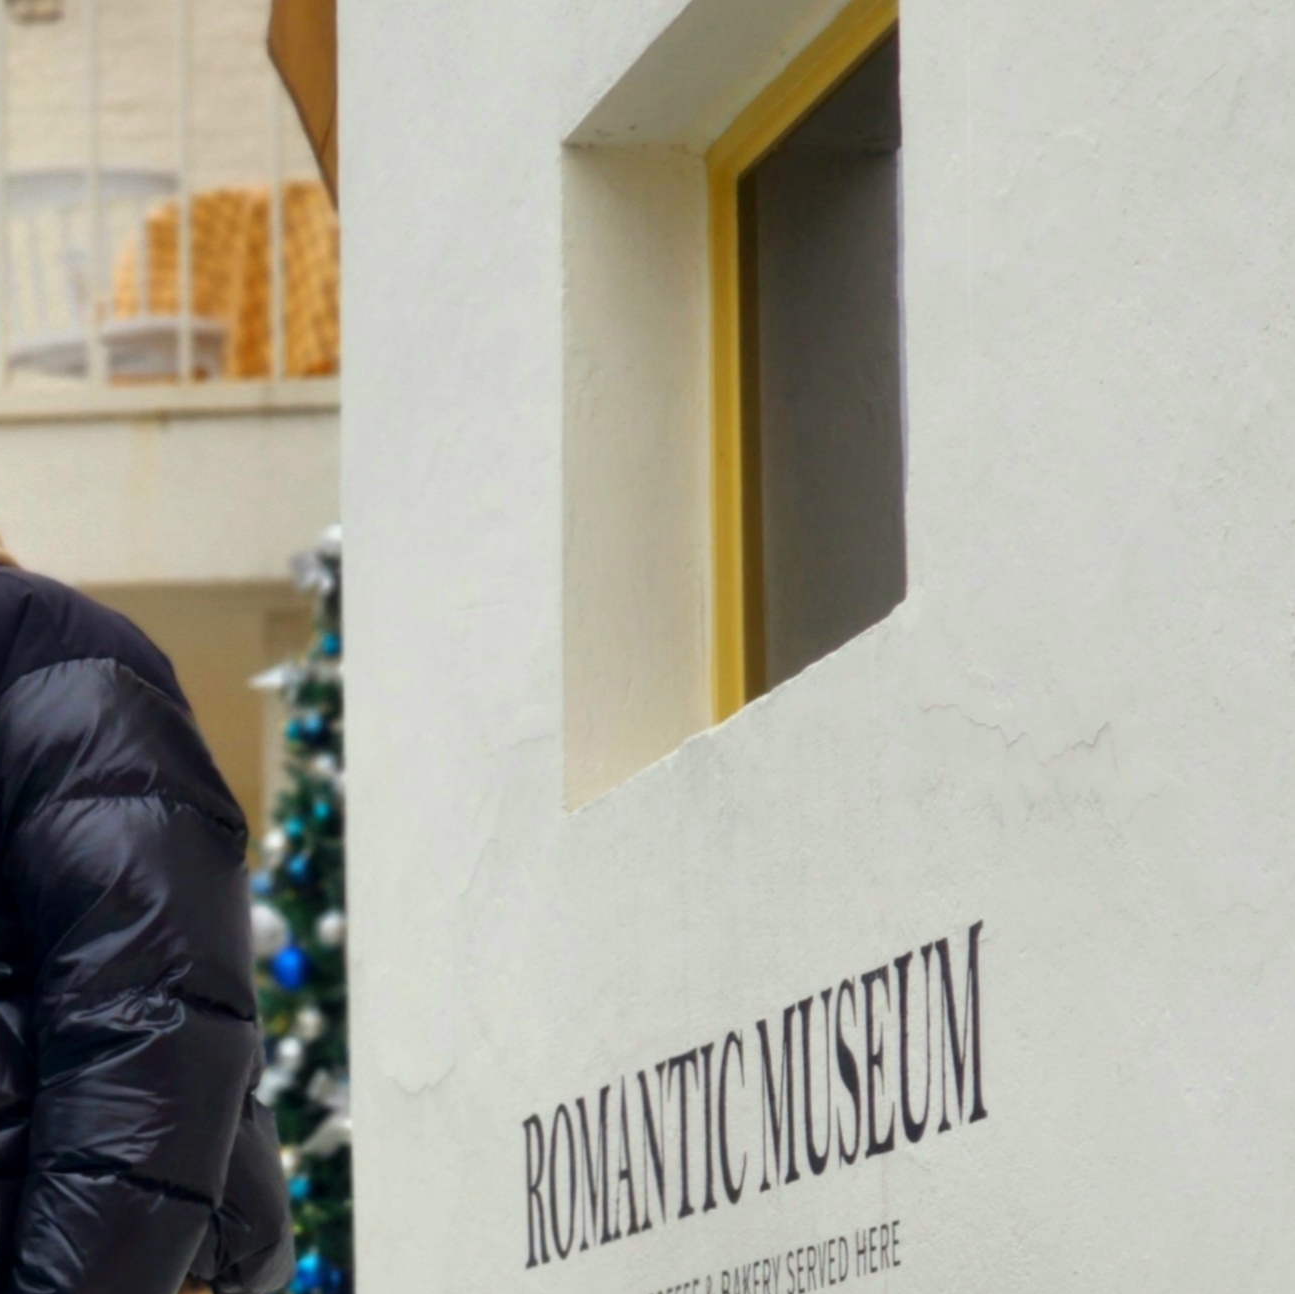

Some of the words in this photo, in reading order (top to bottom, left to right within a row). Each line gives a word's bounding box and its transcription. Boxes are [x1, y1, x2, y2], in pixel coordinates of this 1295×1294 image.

[522, 1029, 747, 1269] ROMANTIC
[756, 920, 988, 1193] MUSEUM
[855, 1220, 901, 1277] HERE
